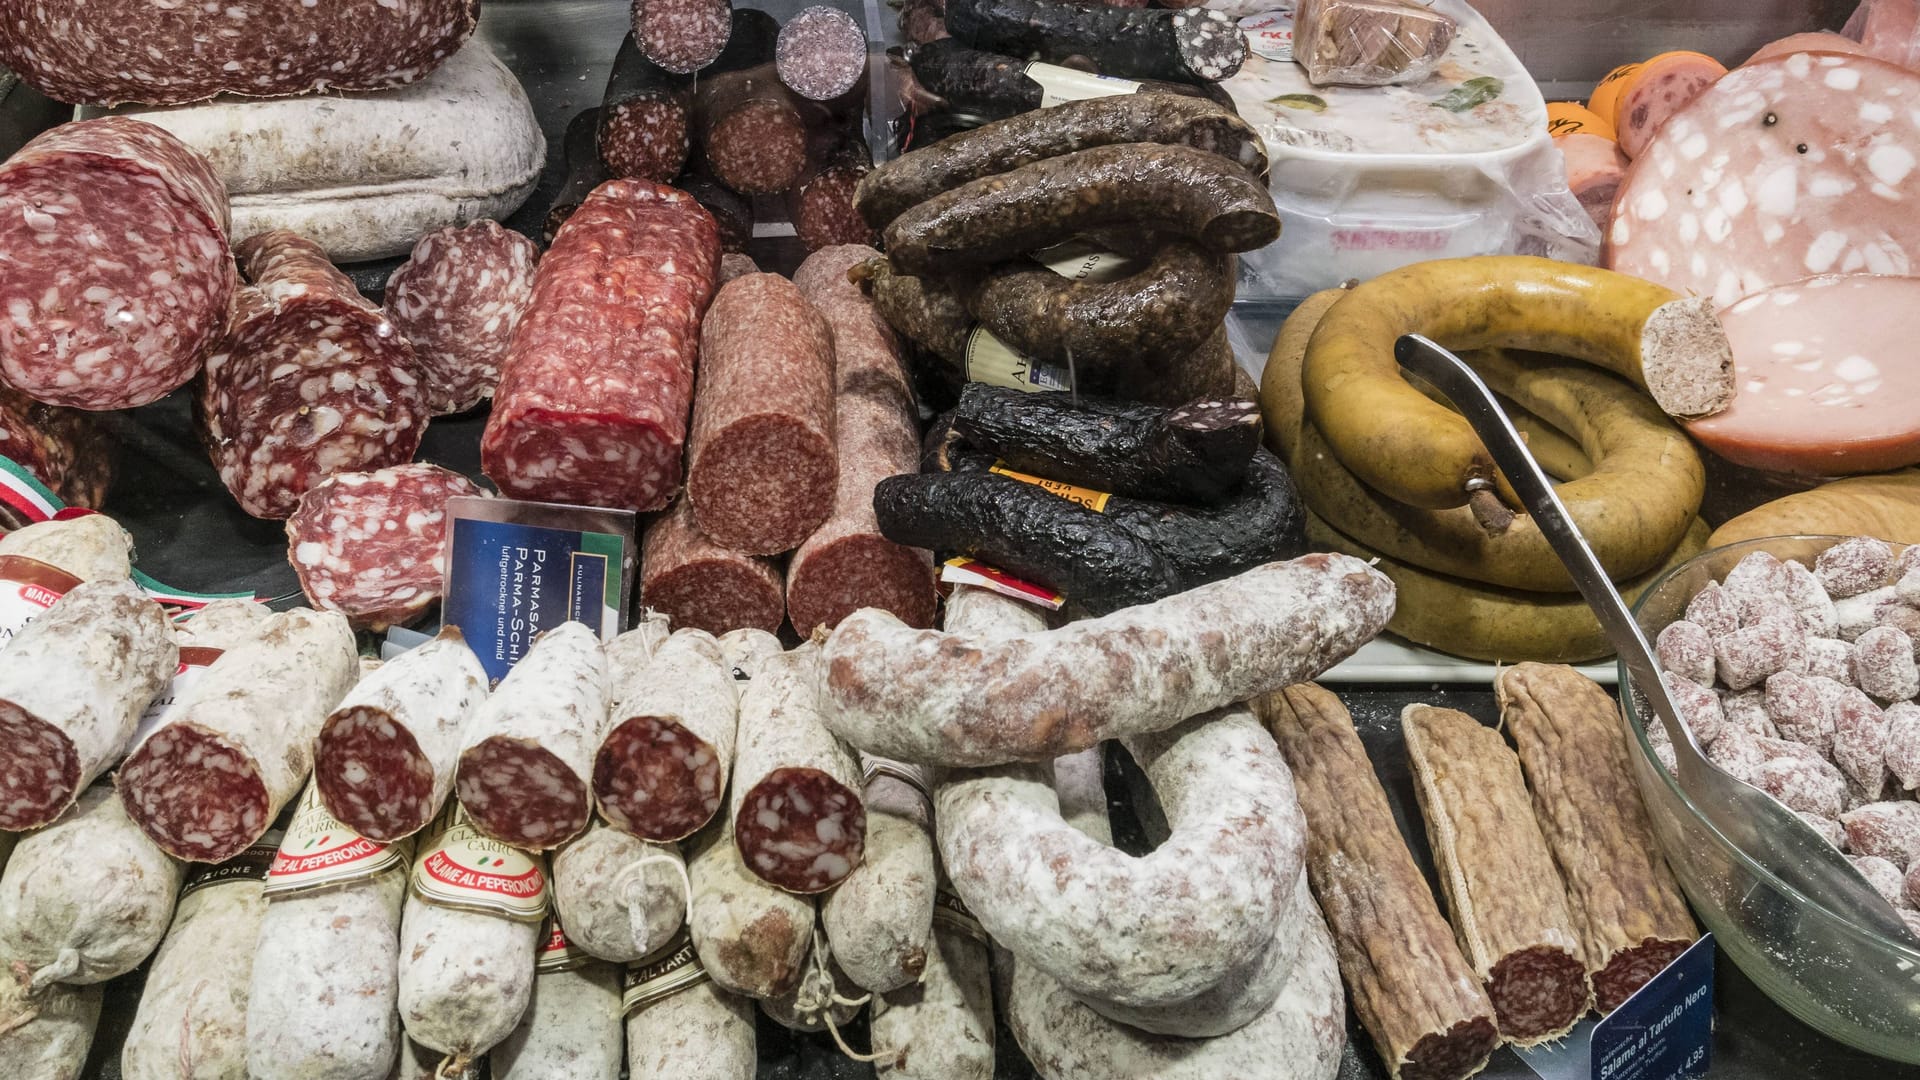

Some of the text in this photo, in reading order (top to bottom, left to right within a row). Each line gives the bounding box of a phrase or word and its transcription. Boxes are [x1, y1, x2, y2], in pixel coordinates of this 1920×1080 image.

[24, 587, 59, 607] MACE
[495, 545, 511, 661] luftgetrocknet und mild
[527, 549, 546, 648] PARMASAL
[428, 853, 463, 883] SALAME
[458, 872, 476, 887] AL
[659, 945, 694, 974] TART
[1600, 1044, 1637, 1080] Salame
[1638, 1031, 1647, 1050] al
[1648, 1004, 1683, 1039] Tartufo
[1685, 984, 1708, 1010] Nero
